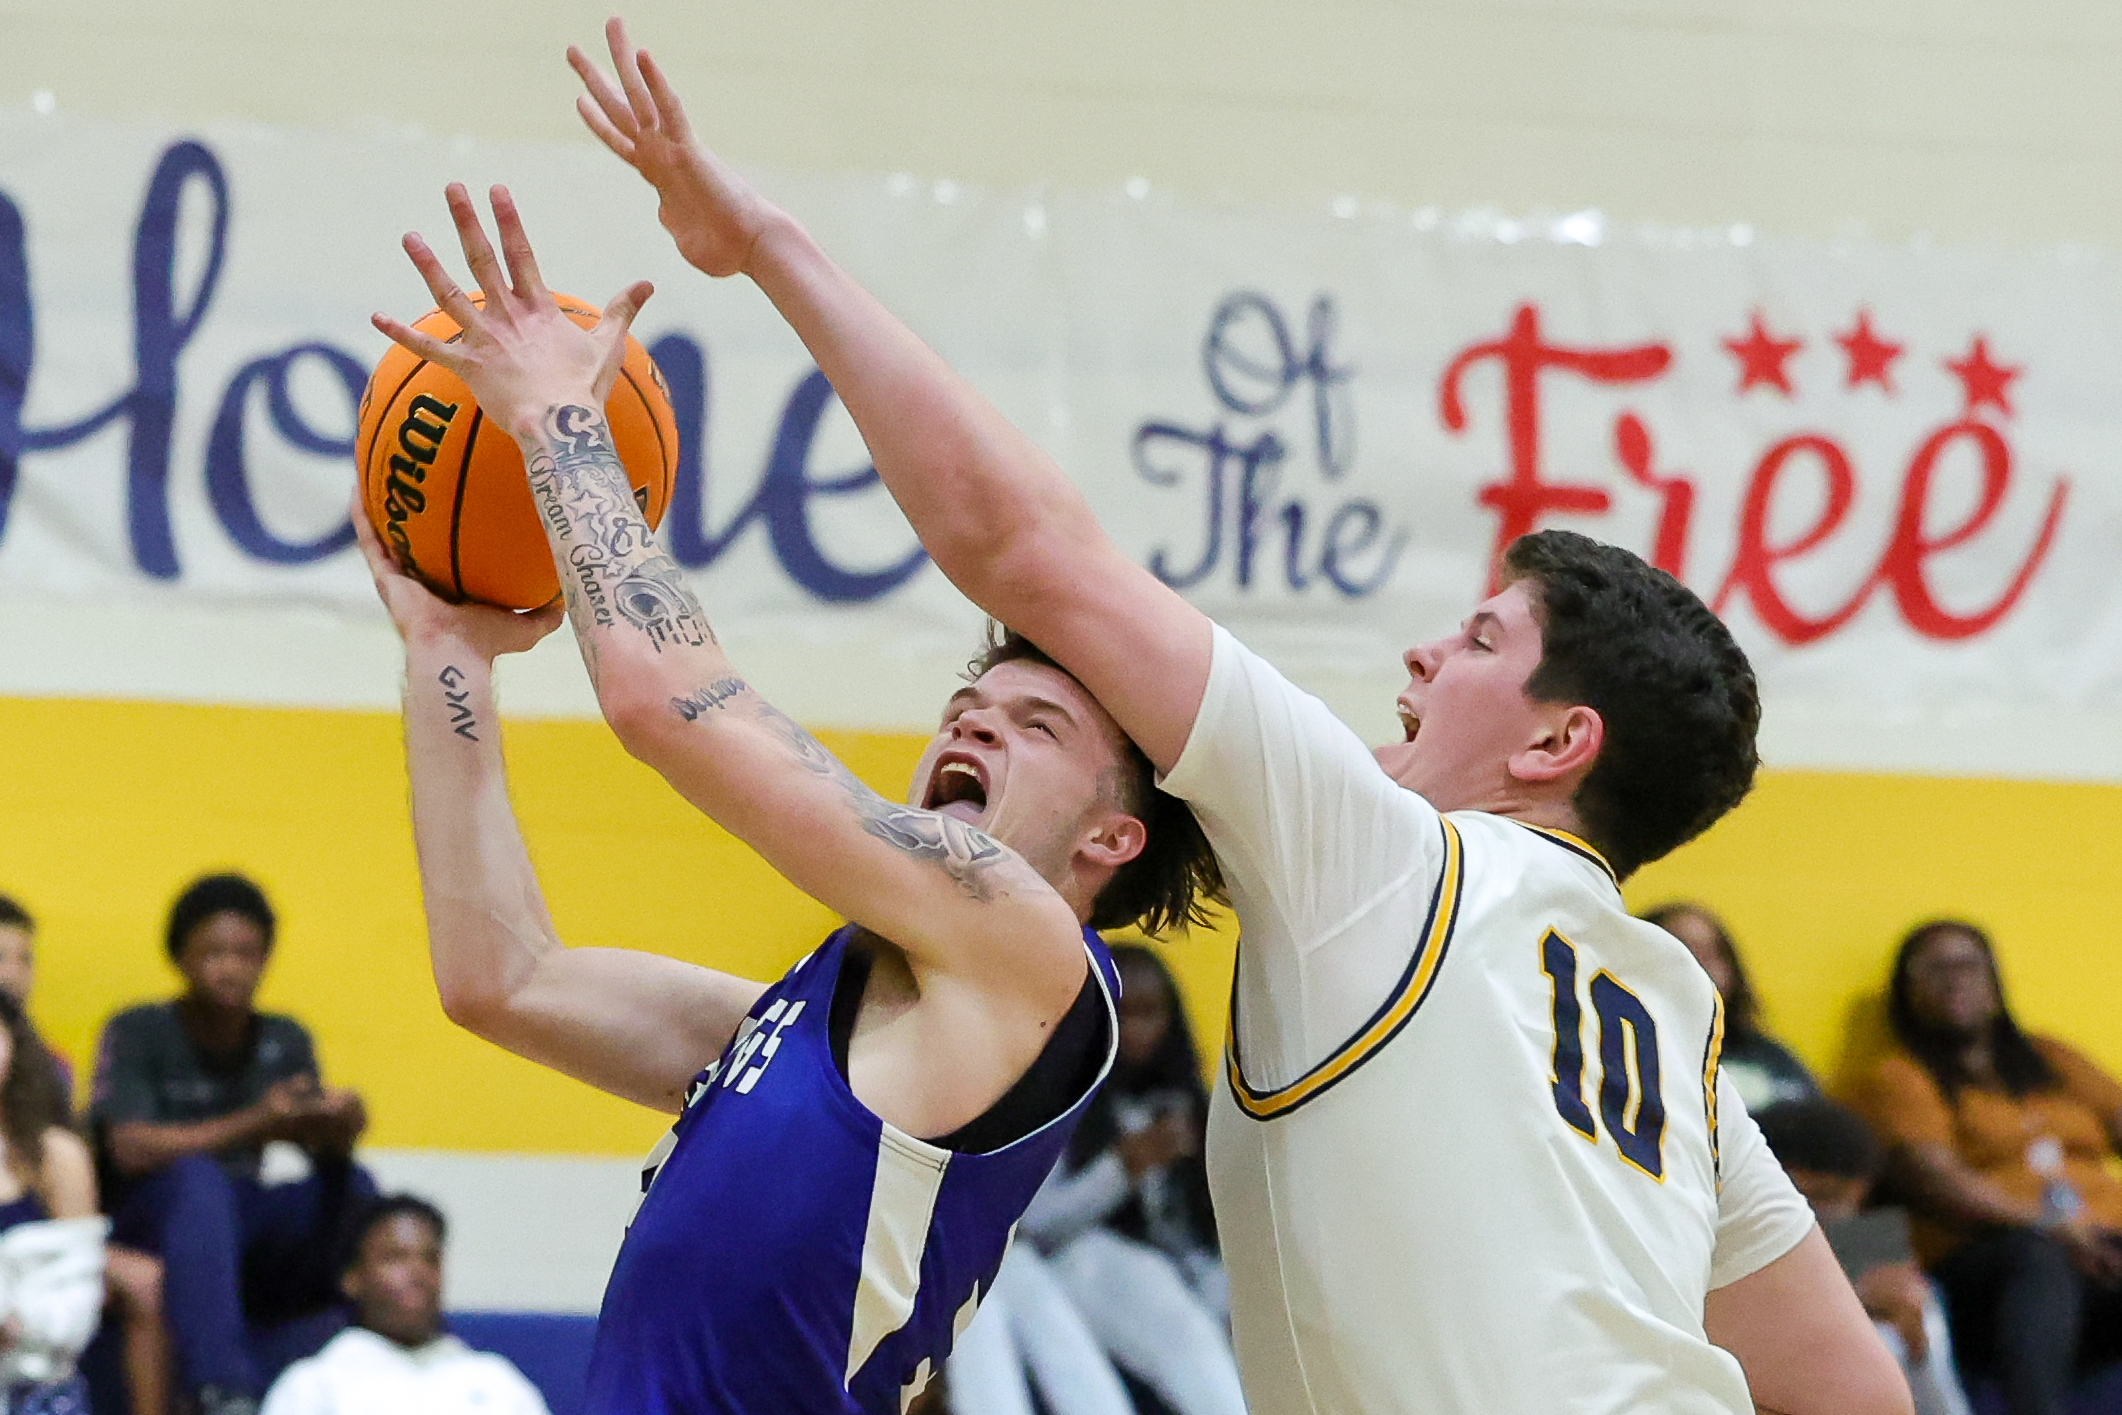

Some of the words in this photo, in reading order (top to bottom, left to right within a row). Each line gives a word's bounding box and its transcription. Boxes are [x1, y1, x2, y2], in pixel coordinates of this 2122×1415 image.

[1200, 288, 1362, 482] Of
[1436, 299, 2074, 648] Free
[529, 450, 574, 541] Dream
[570, 543, 616, 629] Chaser
[1132, 418, 1410, 602] The
[1537, 923, 1669, 1186] 10
